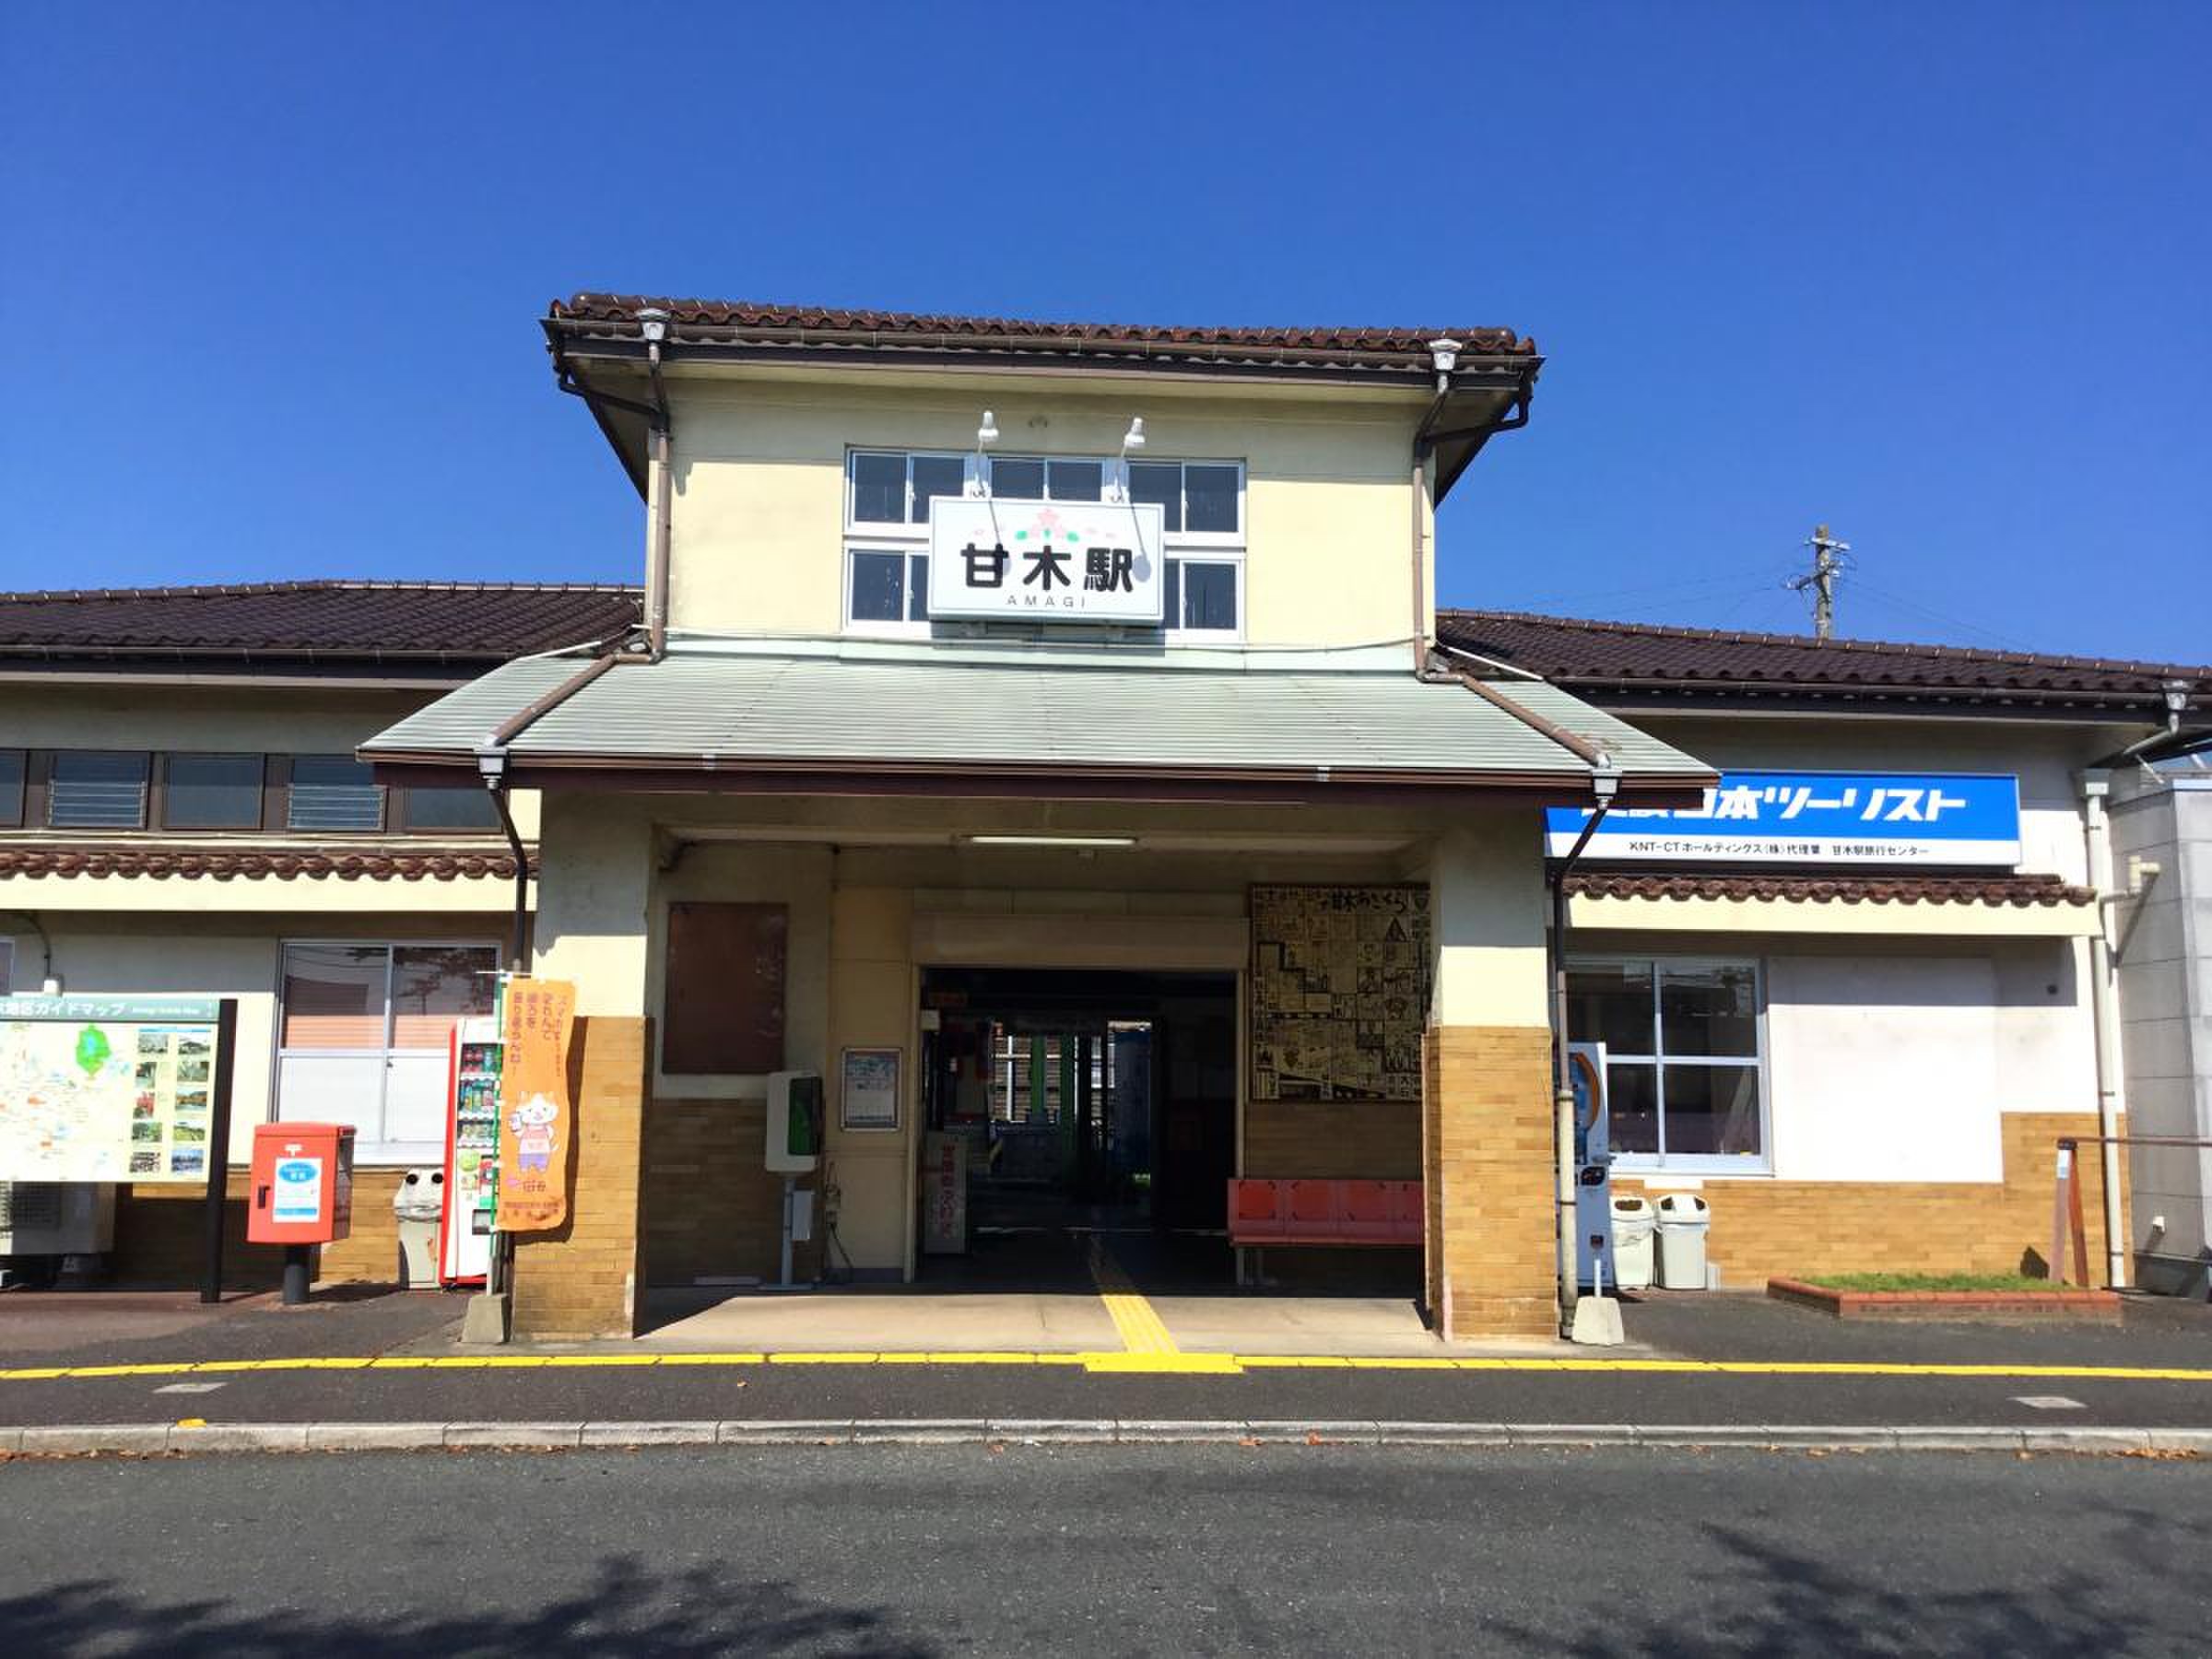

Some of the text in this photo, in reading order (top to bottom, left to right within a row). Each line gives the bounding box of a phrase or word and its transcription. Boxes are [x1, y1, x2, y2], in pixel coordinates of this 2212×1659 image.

[959, 542, 1134, 593] 甘木駅
[1006, 594, 1086, 608] AMAGI
[1581, 786, 1966, 822] 日本ツーリスト
